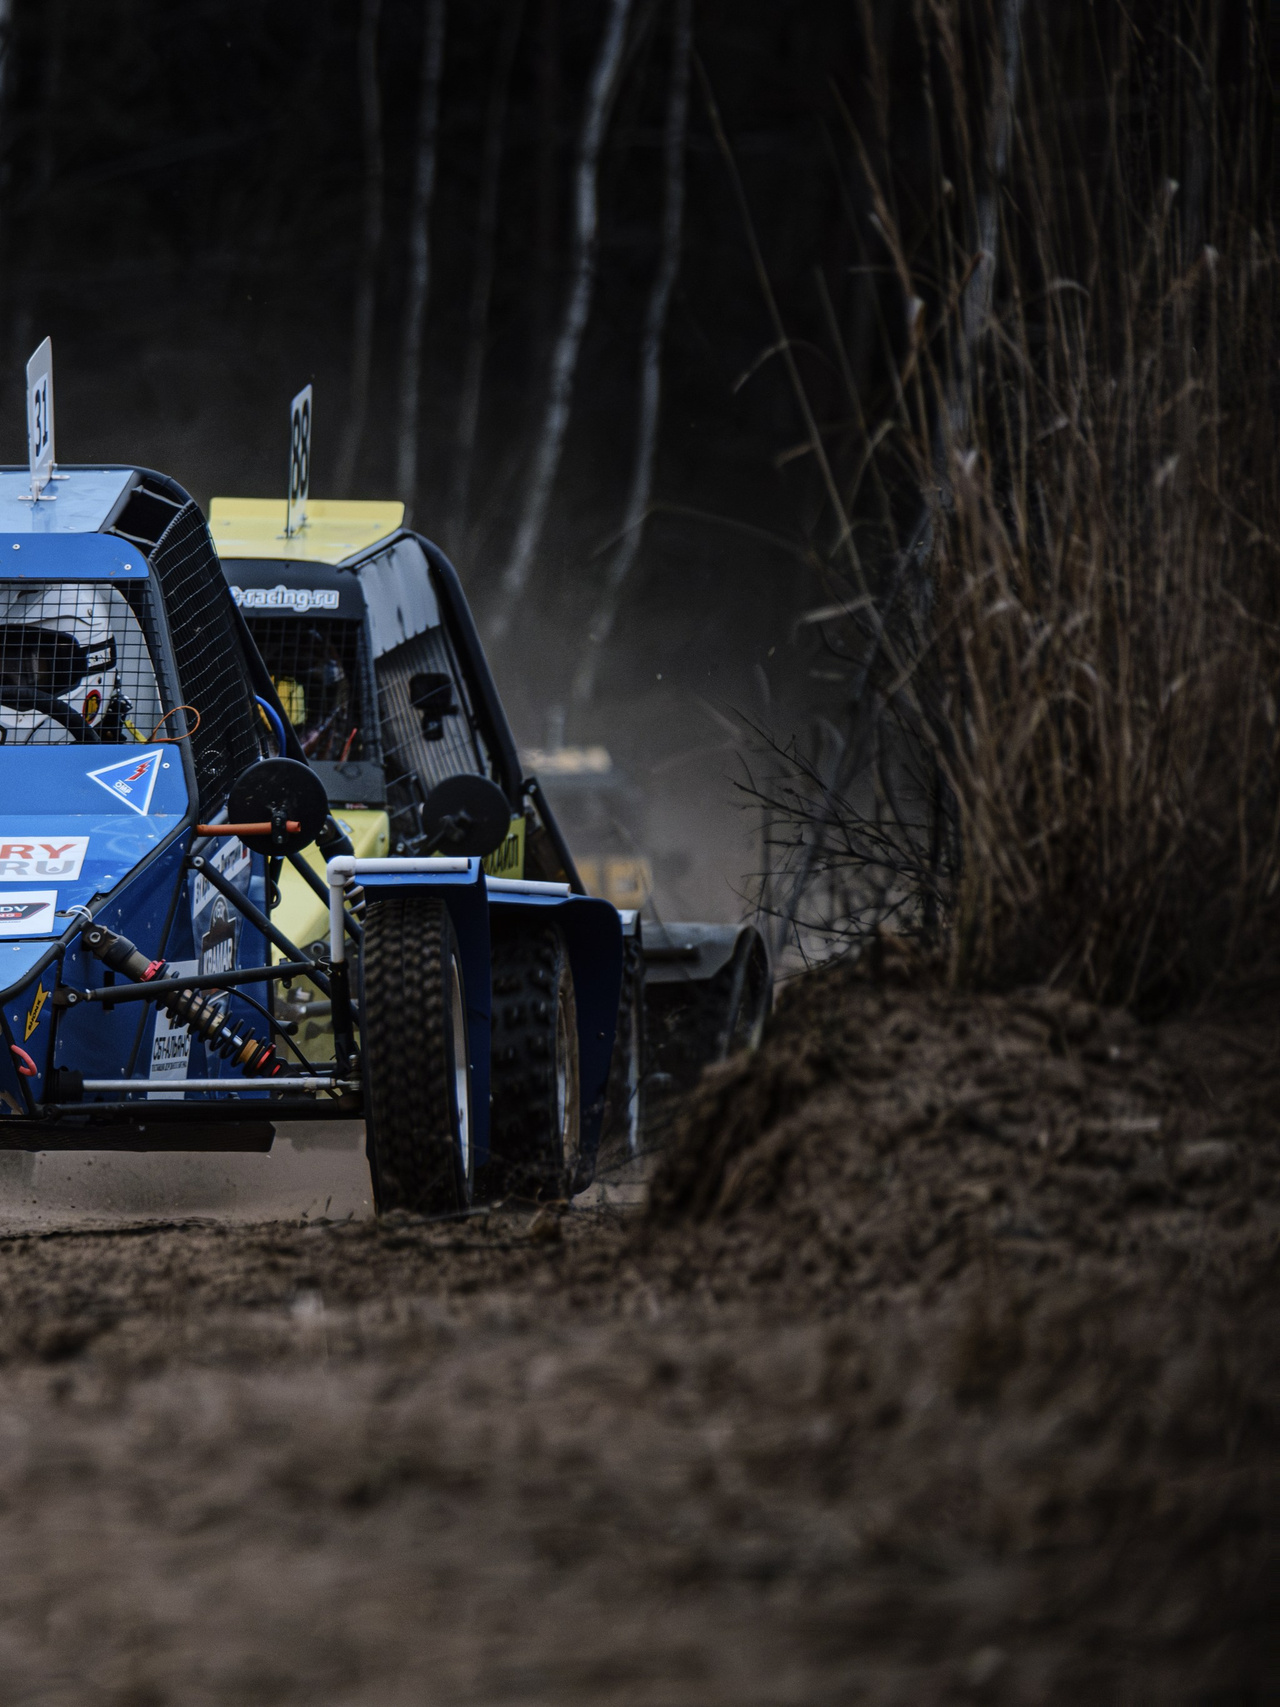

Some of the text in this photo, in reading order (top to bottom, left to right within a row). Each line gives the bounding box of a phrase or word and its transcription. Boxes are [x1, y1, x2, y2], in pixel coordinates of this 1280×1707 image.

[35, 380, 48, 457] 31
[291, 398, 309, 506] 88
[114, 780, 133, 795] OMP
